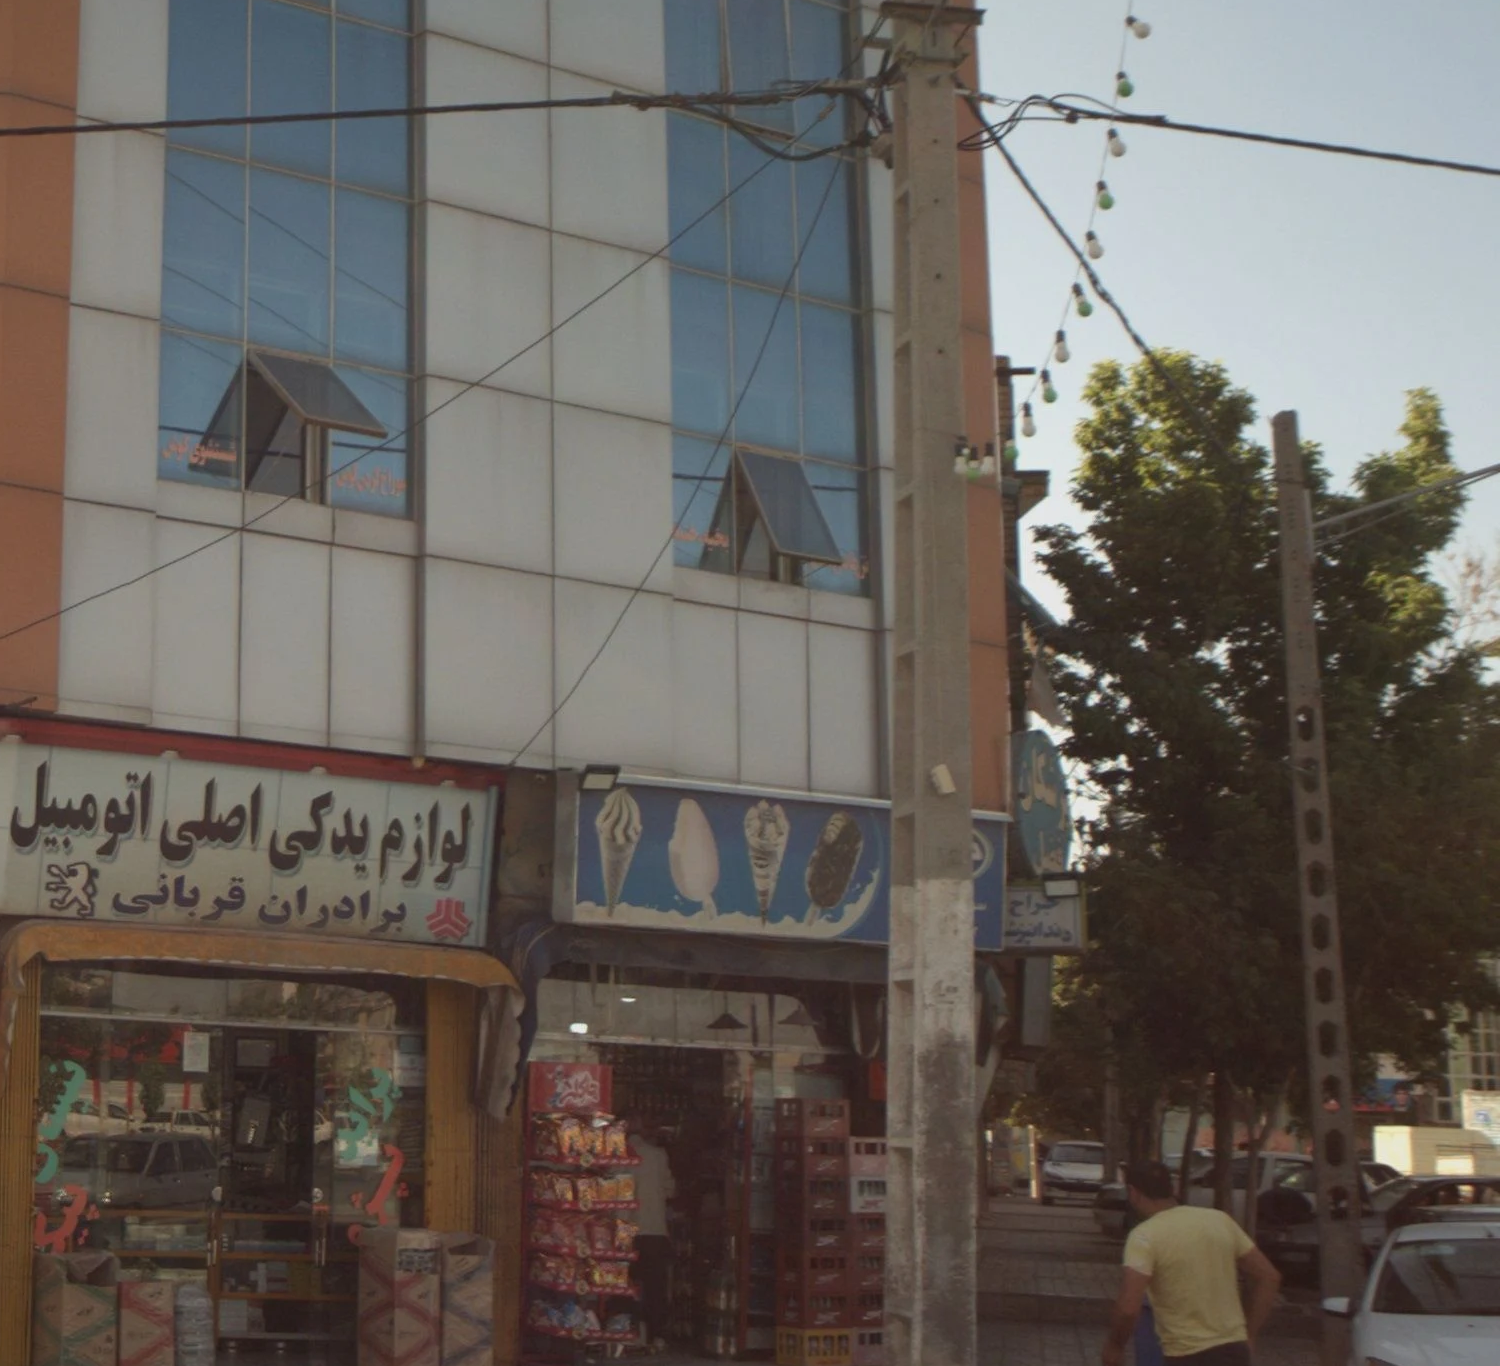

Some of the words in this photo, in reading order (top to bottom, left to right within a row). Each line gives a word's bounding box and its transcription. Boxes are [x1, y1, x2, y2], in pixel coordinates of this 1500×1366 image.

[10, 761, 153, 861] اتومبیل
[159, 778, 264, 865] اصلی
[268, 791, 370, 876] یدکی
[380, 799, 473, 888] لوازم
[112, 874, 246, 921] قربانی
[258, 885, 407, 933] برادران
